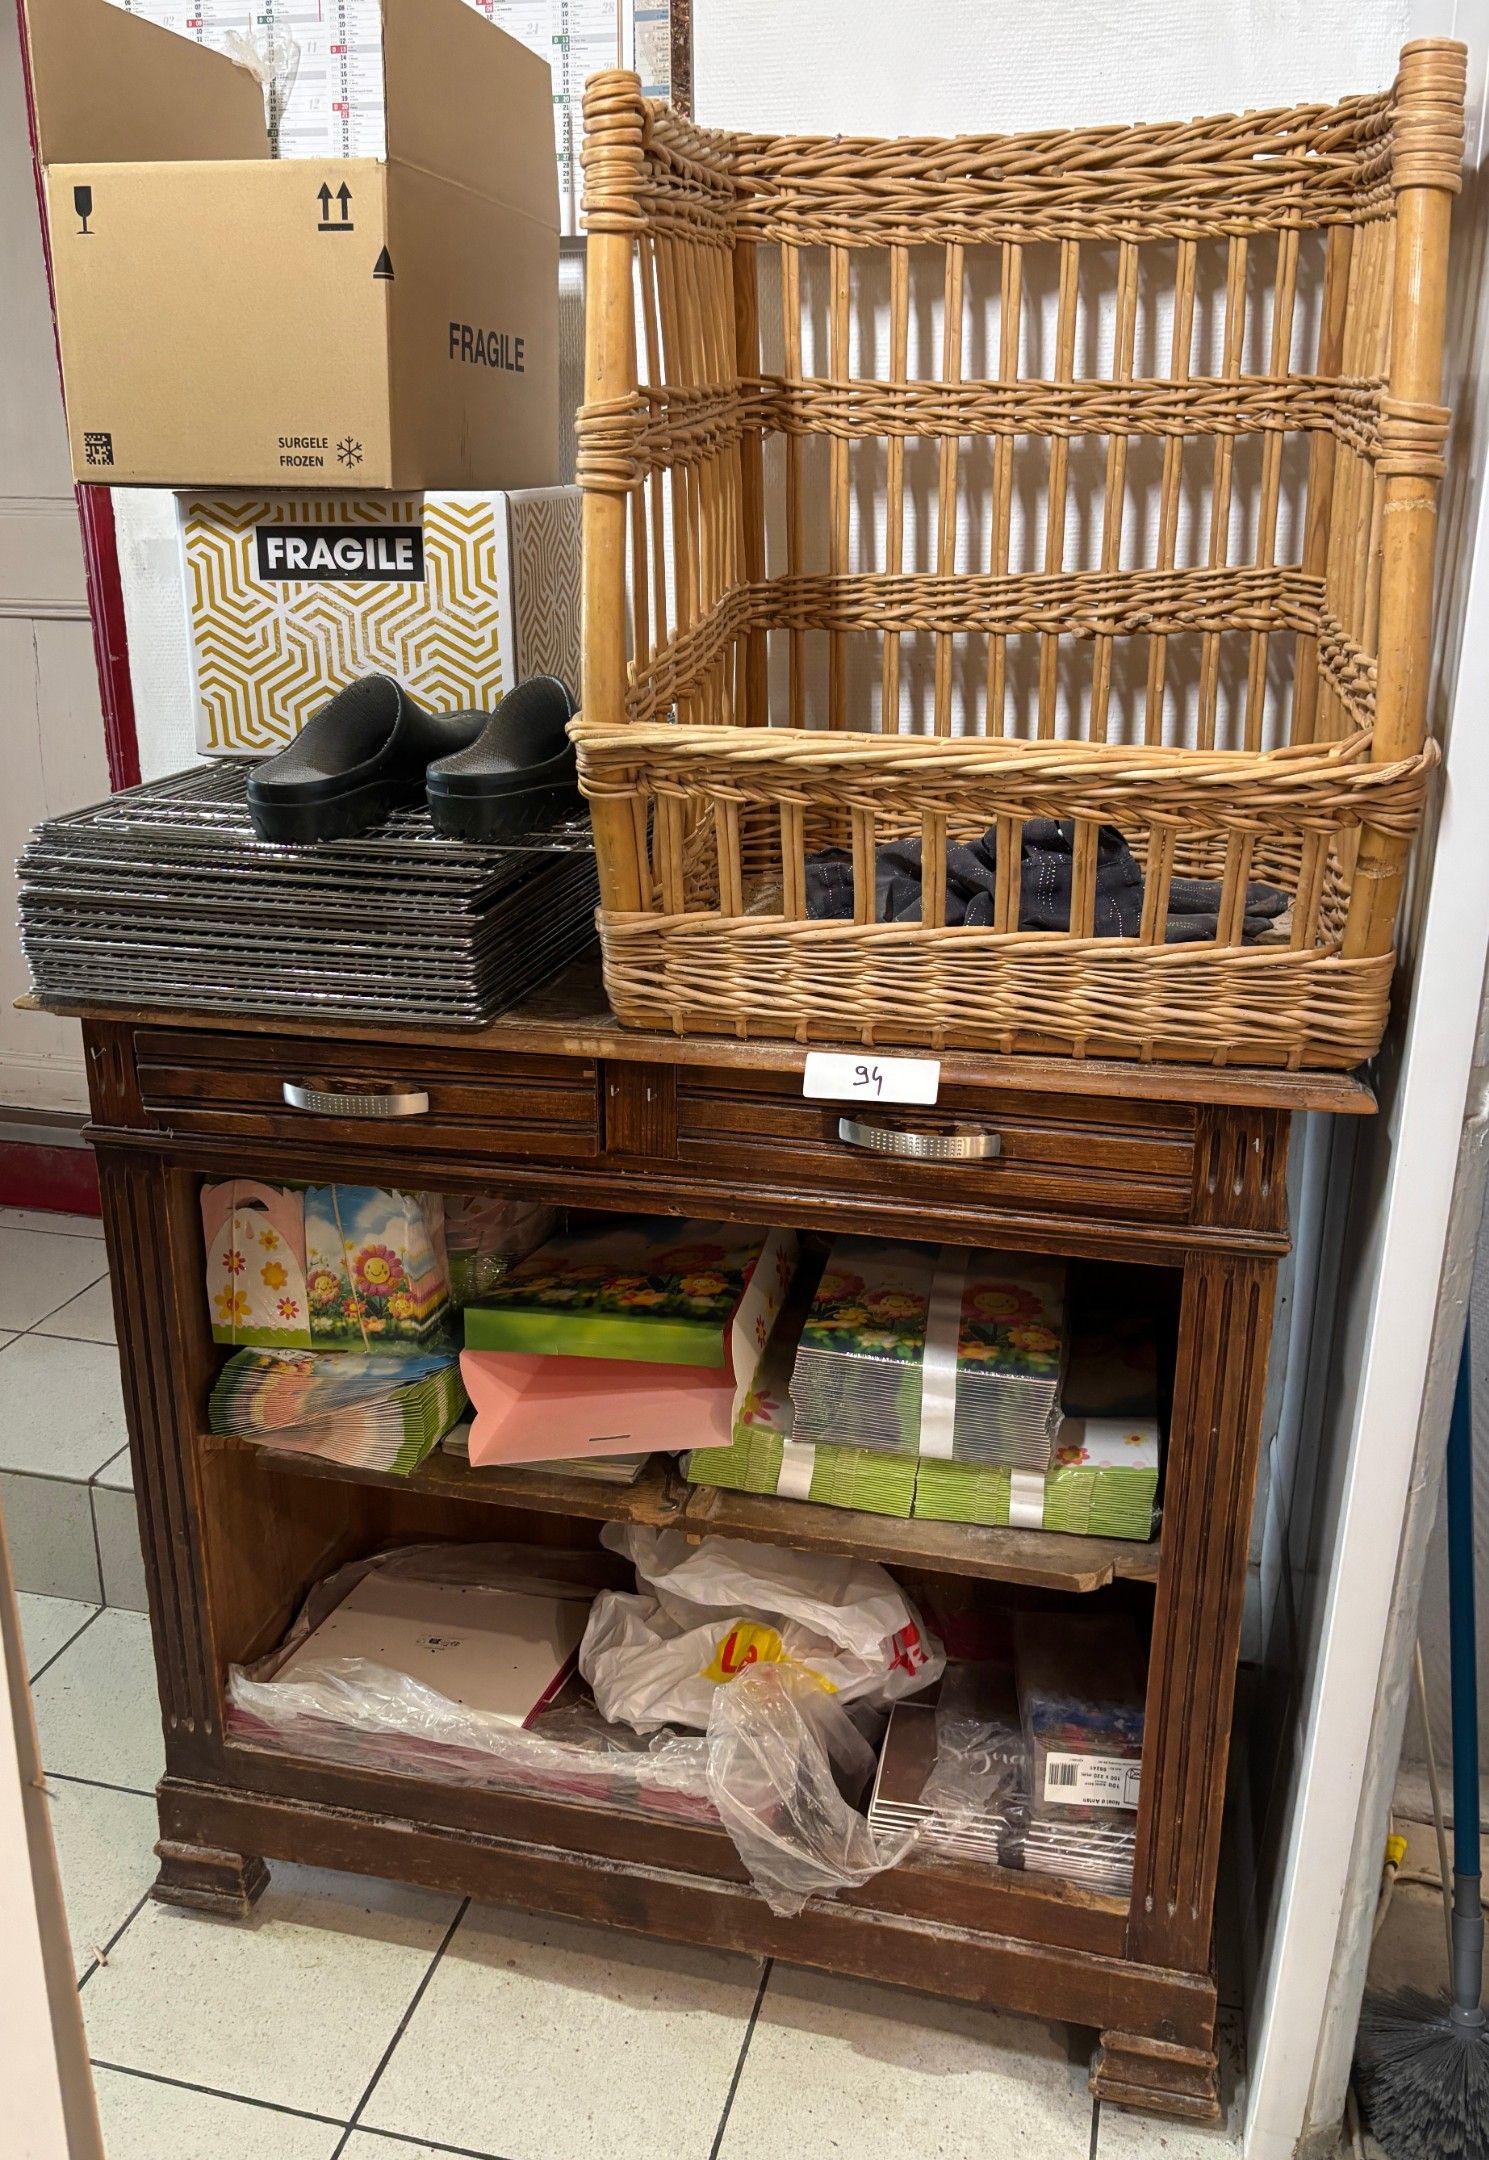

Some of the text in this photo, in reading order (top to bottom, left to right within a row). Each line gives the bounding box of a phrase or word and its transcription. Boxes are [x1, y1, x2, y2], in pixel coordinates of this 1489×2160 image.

[449, 322, 524, 372] FRAGILE
[278, 437, 328, 448] SURGELE
[279, 456, 324, 466] FROZEN
[266, 537, 414, 571] FRAGILE
[853, 1066, 882, 1096] 94
